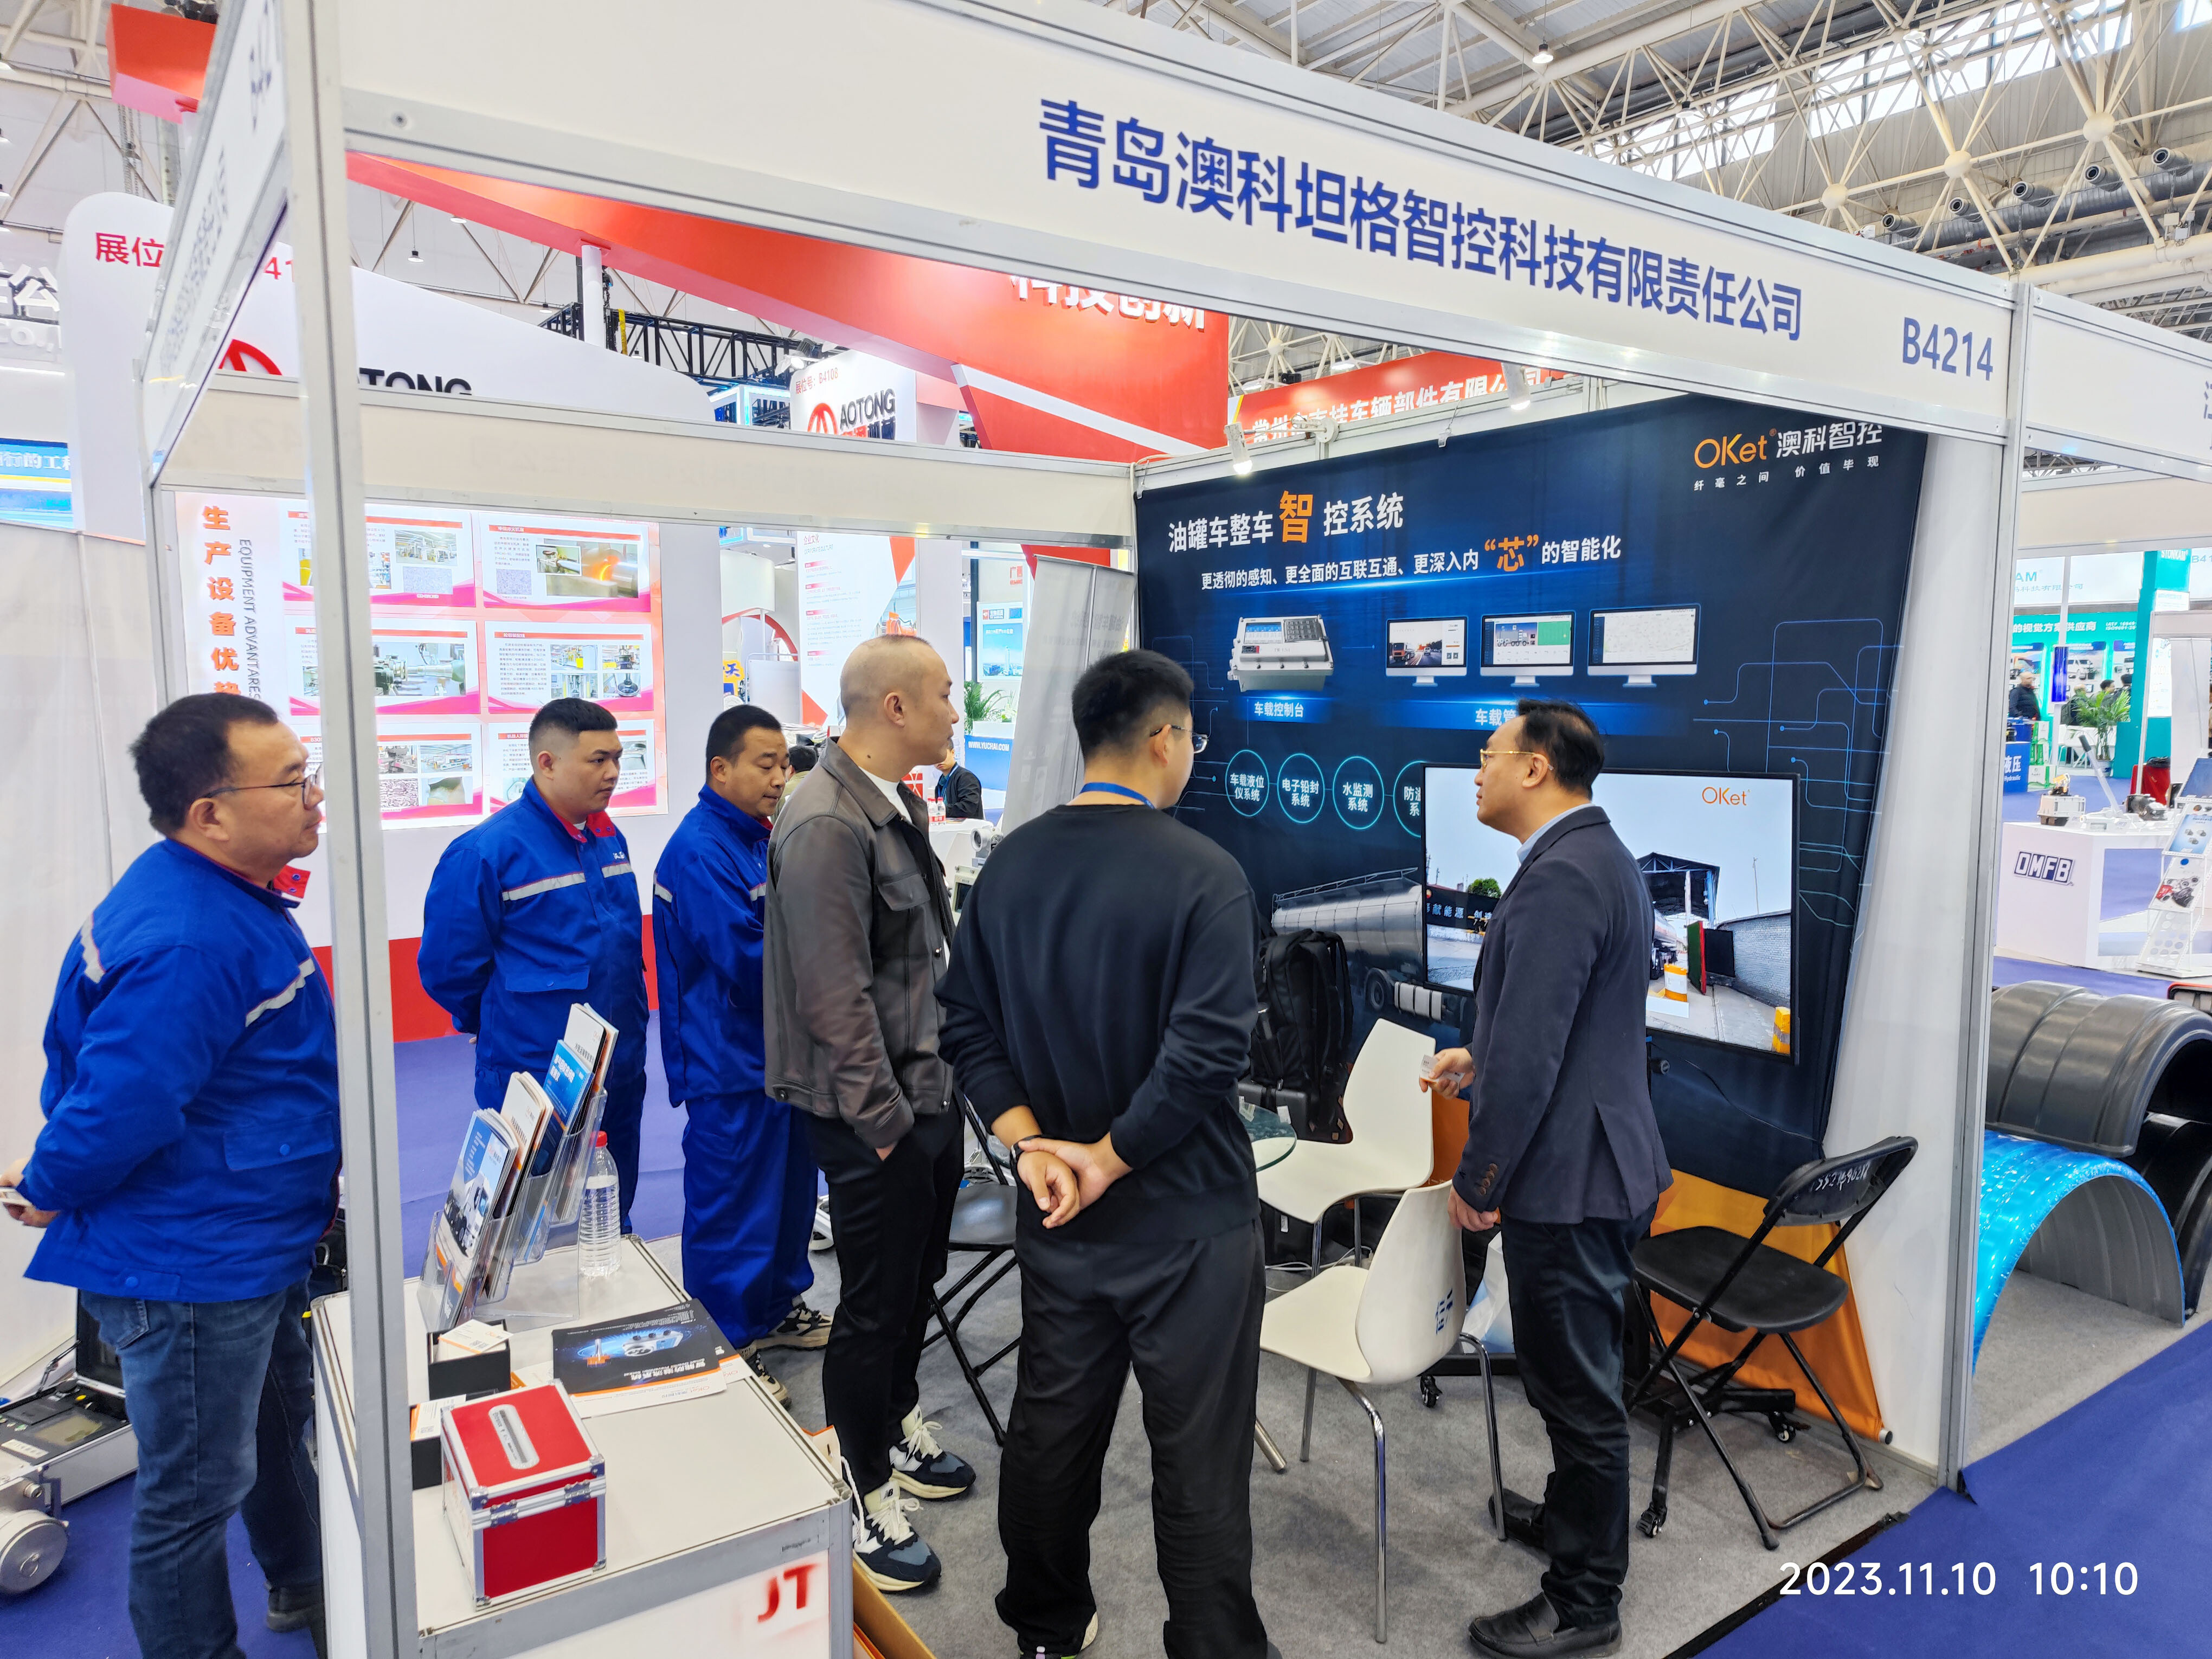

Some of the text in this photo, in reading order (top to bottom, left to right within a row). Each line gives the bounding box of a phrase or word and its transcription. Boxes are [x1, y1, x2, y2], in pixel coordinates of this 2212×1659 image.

[1039, 98, 1802, 341] 青岛澳科坦格智控科技有限责任公司
[1902, 317, 1994, 381] B4214
[819, 367, 839, 384] B4108
[840, 388, 895, 430] AOTONG
[1694, 421, 1883, 470] OKet 澳科智控
[1694, 455, 1880, 491] 纤毫之间 价值毕现
[240, 538, 258, 613] EQUIPMENT
[1254, 702, 1304, 719] 车载控制台
[968, 741, 1010, 752] WWW.YUCHAI.COM
[1230, 773, 1265, 789] 车载液位
[1282, 778, 1320, 795] 电子铅封
[1342, 781, 1374, 799] 水监测
[1234, 787, 1261, 802] 仪系统
[1291, 792, 1310, 808] 系统
[1702, 787, 1748, 806] OKet
[1348, 796, 1368, 813] 系统
[757, 1563, 820, 1624] JT
